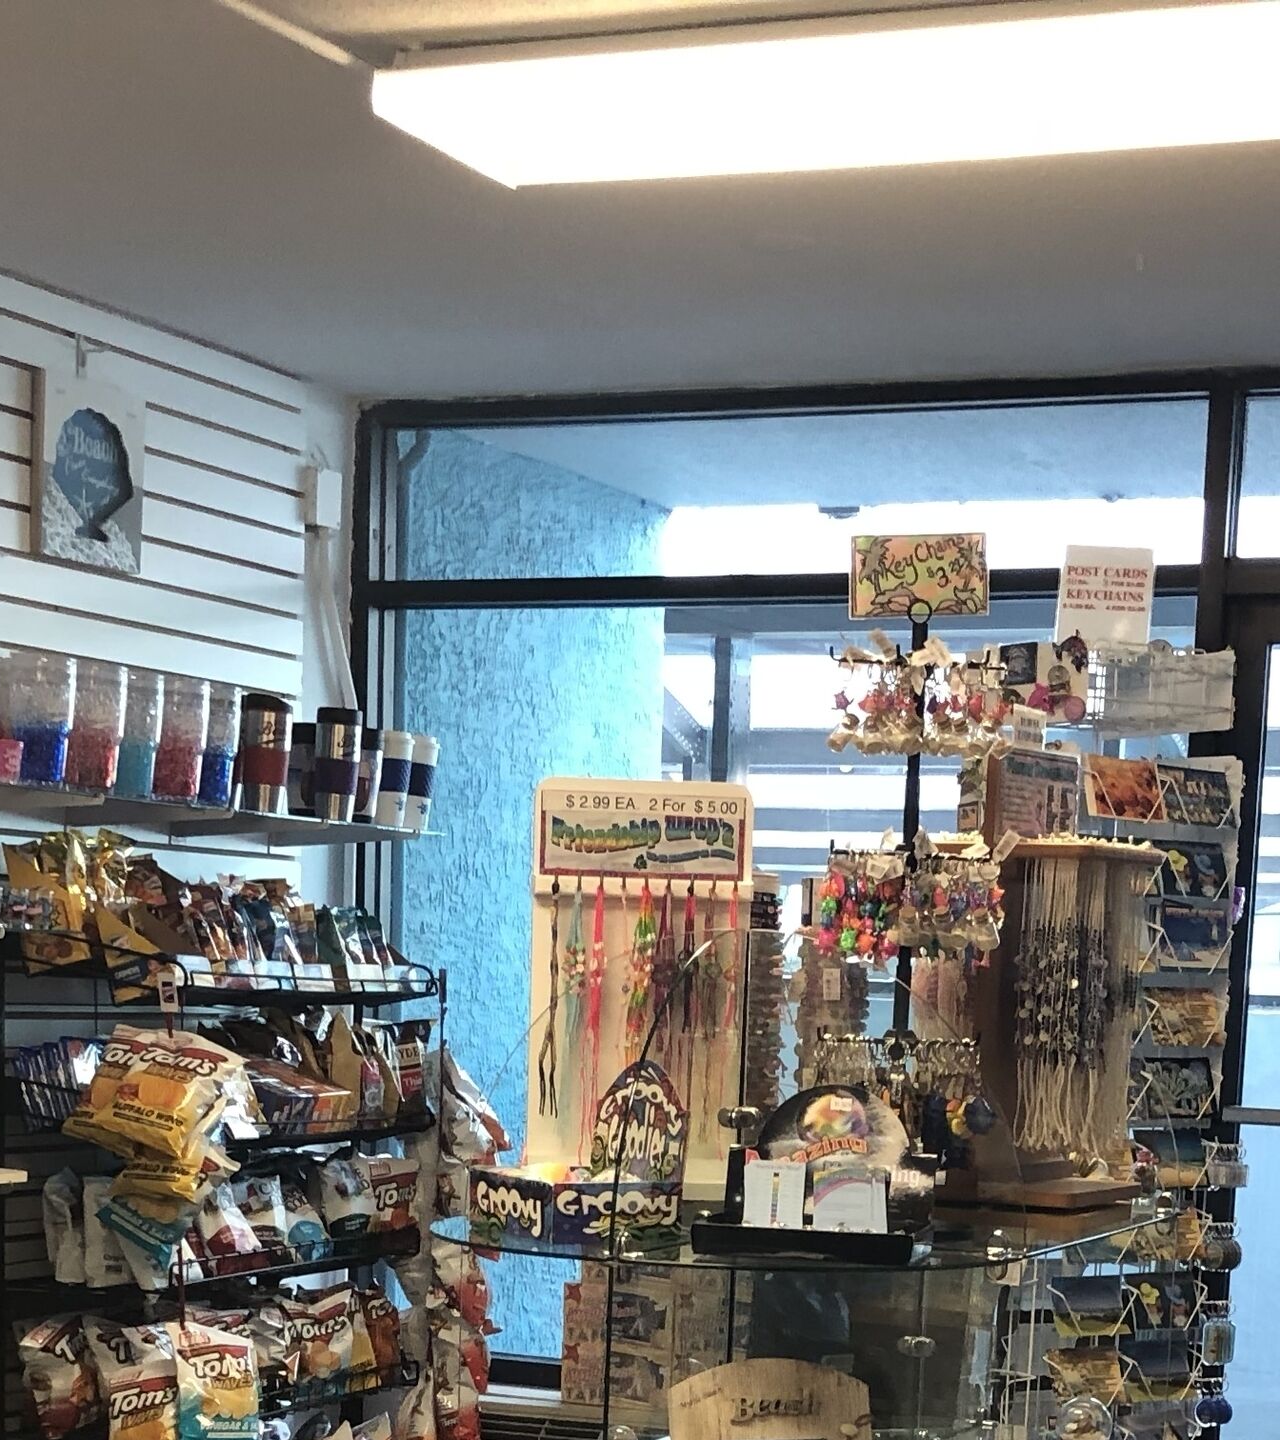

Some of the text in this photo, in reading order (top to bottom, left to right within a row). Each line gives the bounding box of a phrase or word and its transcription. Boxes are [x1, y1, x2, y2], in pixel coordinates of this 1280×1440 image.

[1067, 565, 1148, 579] POST CARDS
[1066, 588, 1144, 602] KEYCHAINS
[579, 796, 610, 809] 2.99
[649, 799, 658, 811] 2
[662, 799, 686, 812] For
[694, 800, 704, 813] $
[707, 802, 738, 815] 5.00
[140, 1046, 218, 1077] Tom's
[112, 1102, 184, 1127] BUFFALO WING
[600, 1082, 682, 1137] Groovy
[476, 1181, 542, 1238] Groovy
[556, 1190, 678, 1225] Groovy
[109, 1385, 177, 1419] Tom's
